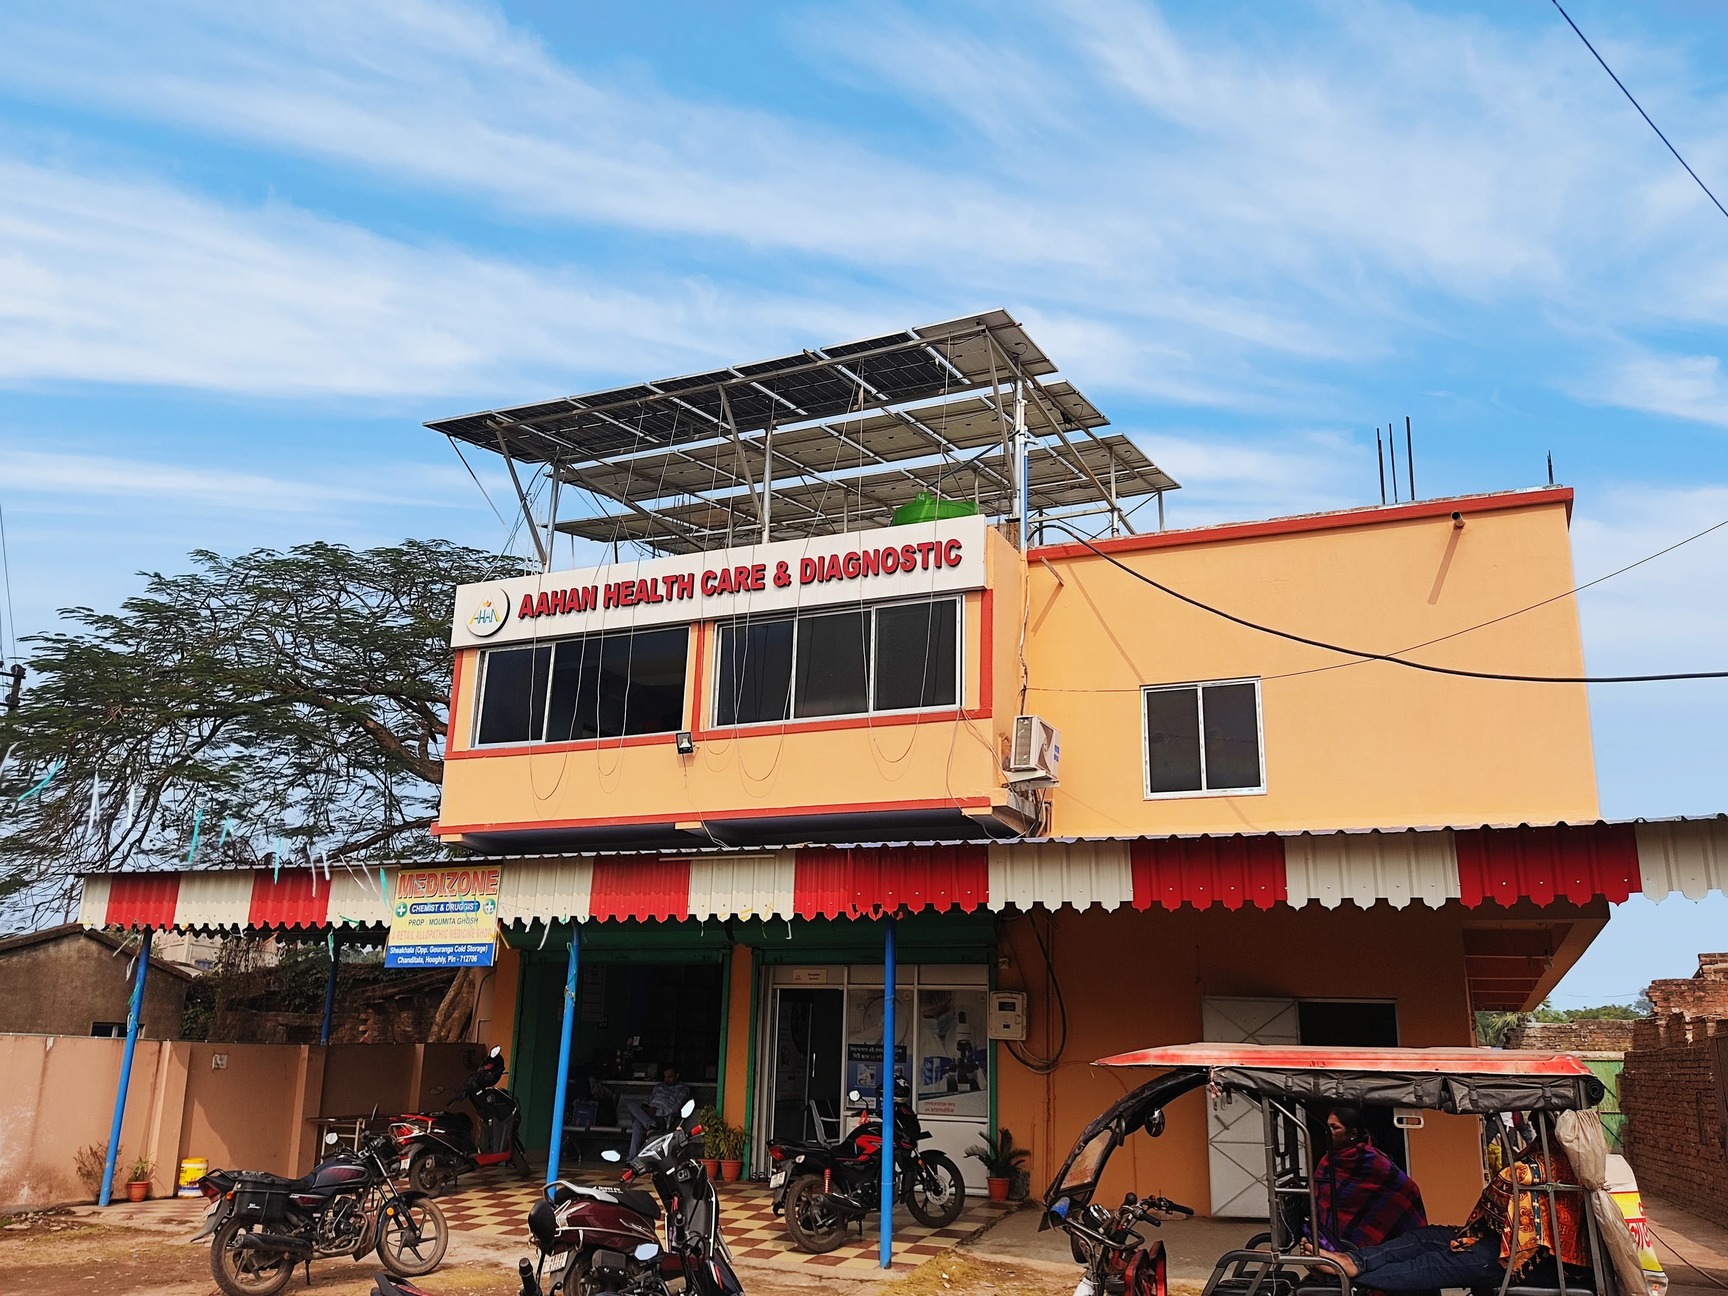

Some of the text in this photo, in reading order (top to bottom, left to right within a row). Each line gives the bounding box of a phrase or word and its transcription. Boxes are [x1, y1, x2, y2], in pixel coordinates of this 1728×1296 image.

[518, 539, 962, 618] AAHAN HEALTH CARE & DIAGNOSTIC
[398, 870, 499, 899] MEDIZONE
[411, 904, 439, 913] CHEMIST
[446, 903, 478, 911] DRUGGIST
[397, 931, 414, 940] RETAIL
[416, 930, 448, 940] ALLOPATHIC
[450, 929, 475, 938] MEDICINE
[415, 947, 428, 955] (Opp.
[430, 946, 453, 954] Gouranga
[467, 945, 488, 953] Storage)
[425, 956, 446, 964] Hooghly,
